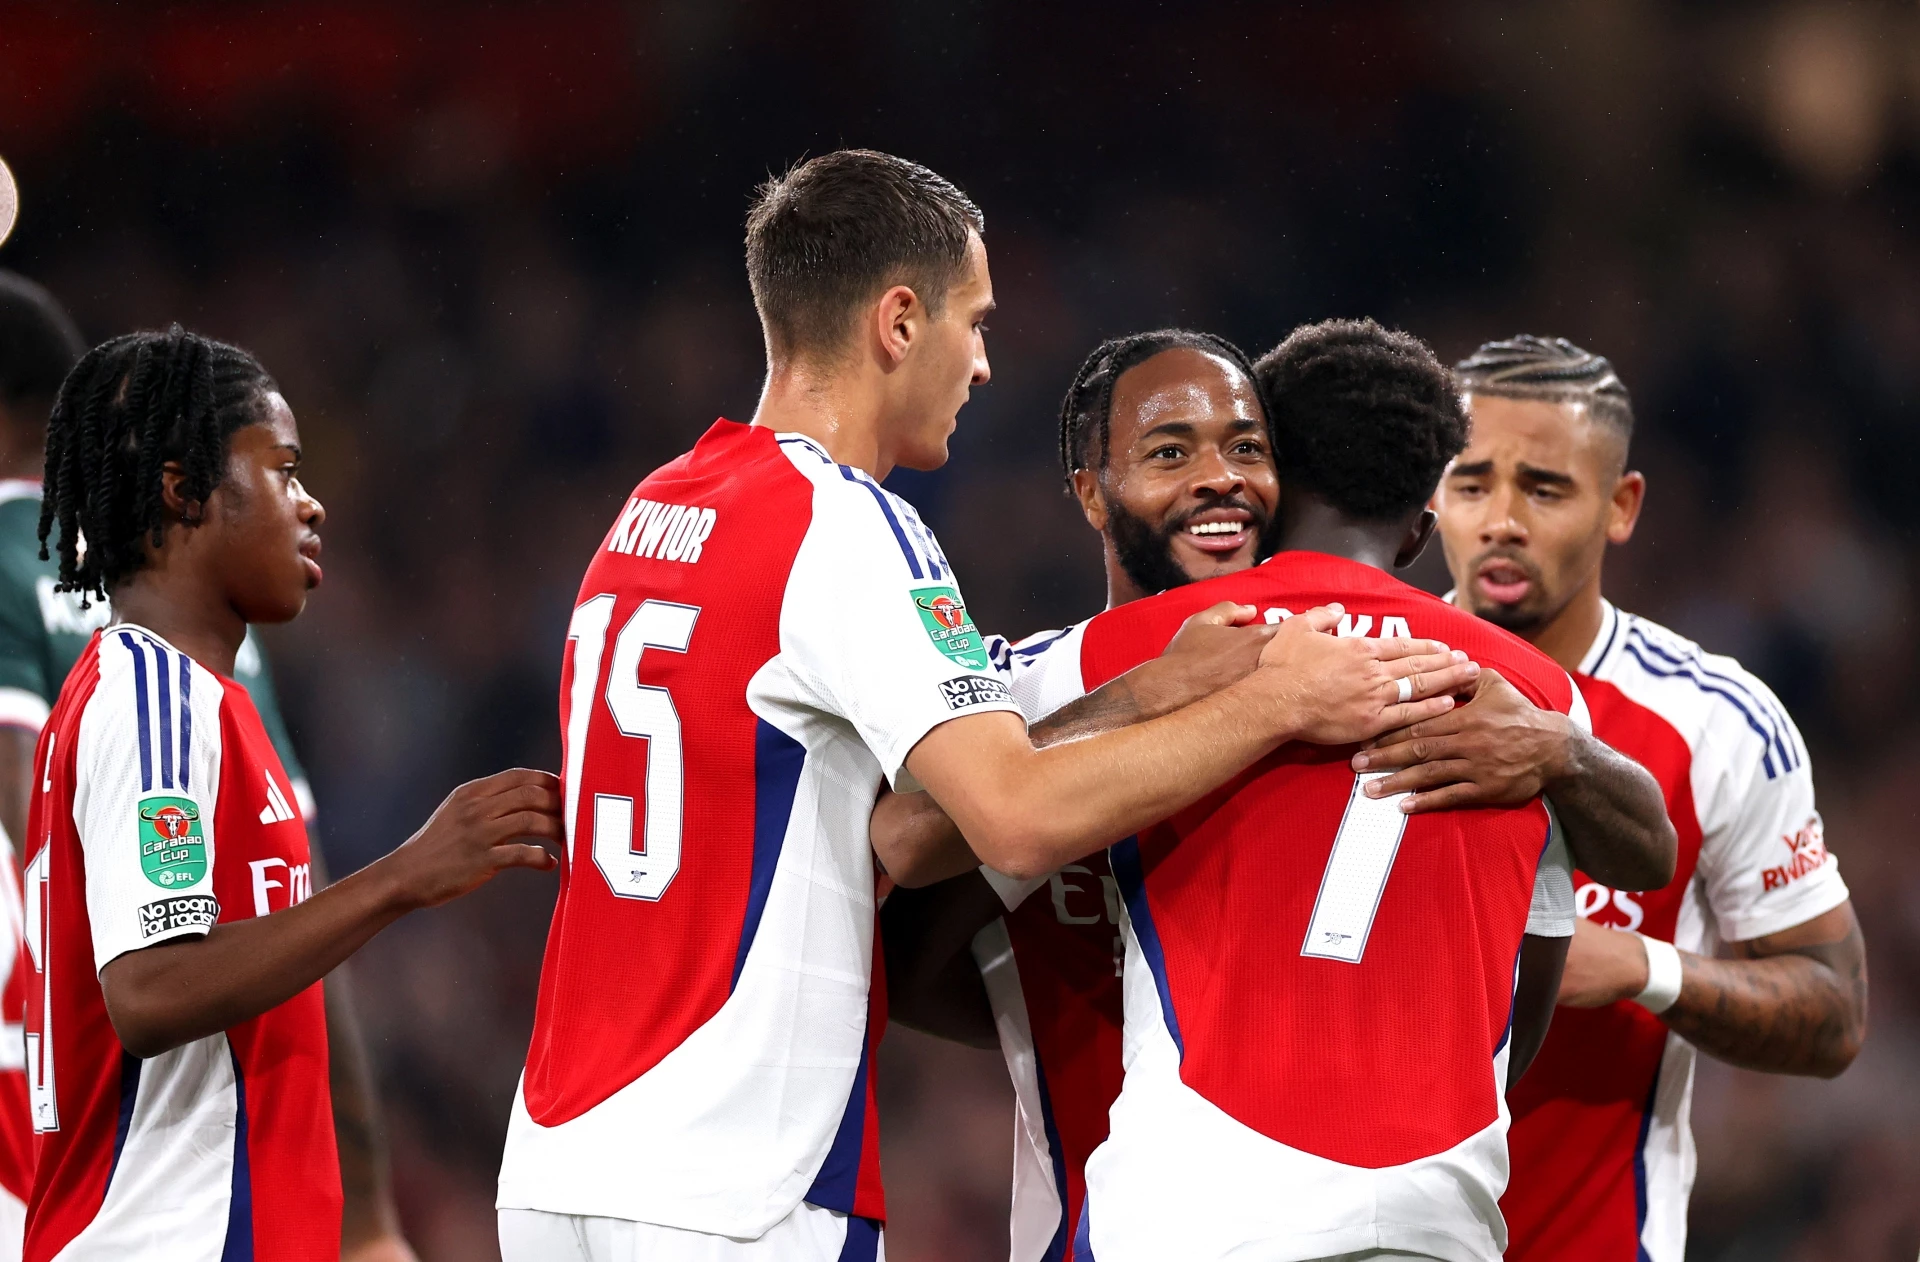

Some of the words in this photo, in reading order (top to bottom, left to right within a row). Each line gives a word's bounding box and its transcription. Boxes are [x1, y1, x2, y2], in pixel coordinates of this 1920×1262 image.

[607, 497, 717, 564] KIWIOR
[930, 623, 976, 640] Carabao
[947, 638, 969, 650] Cup
[940, 680, 969, 698] No
[947, 692, 973, 710] for
[565, 592, 702, 902] 15
[143, 835, 203, 856] Carabao
[160, 849, 189, 863] Cup
[176, 873, 195, 881] EFL
[139, 904, 166, 920] No
[168, 898, 217, 914] room
[141, 916, 168, 938] for
